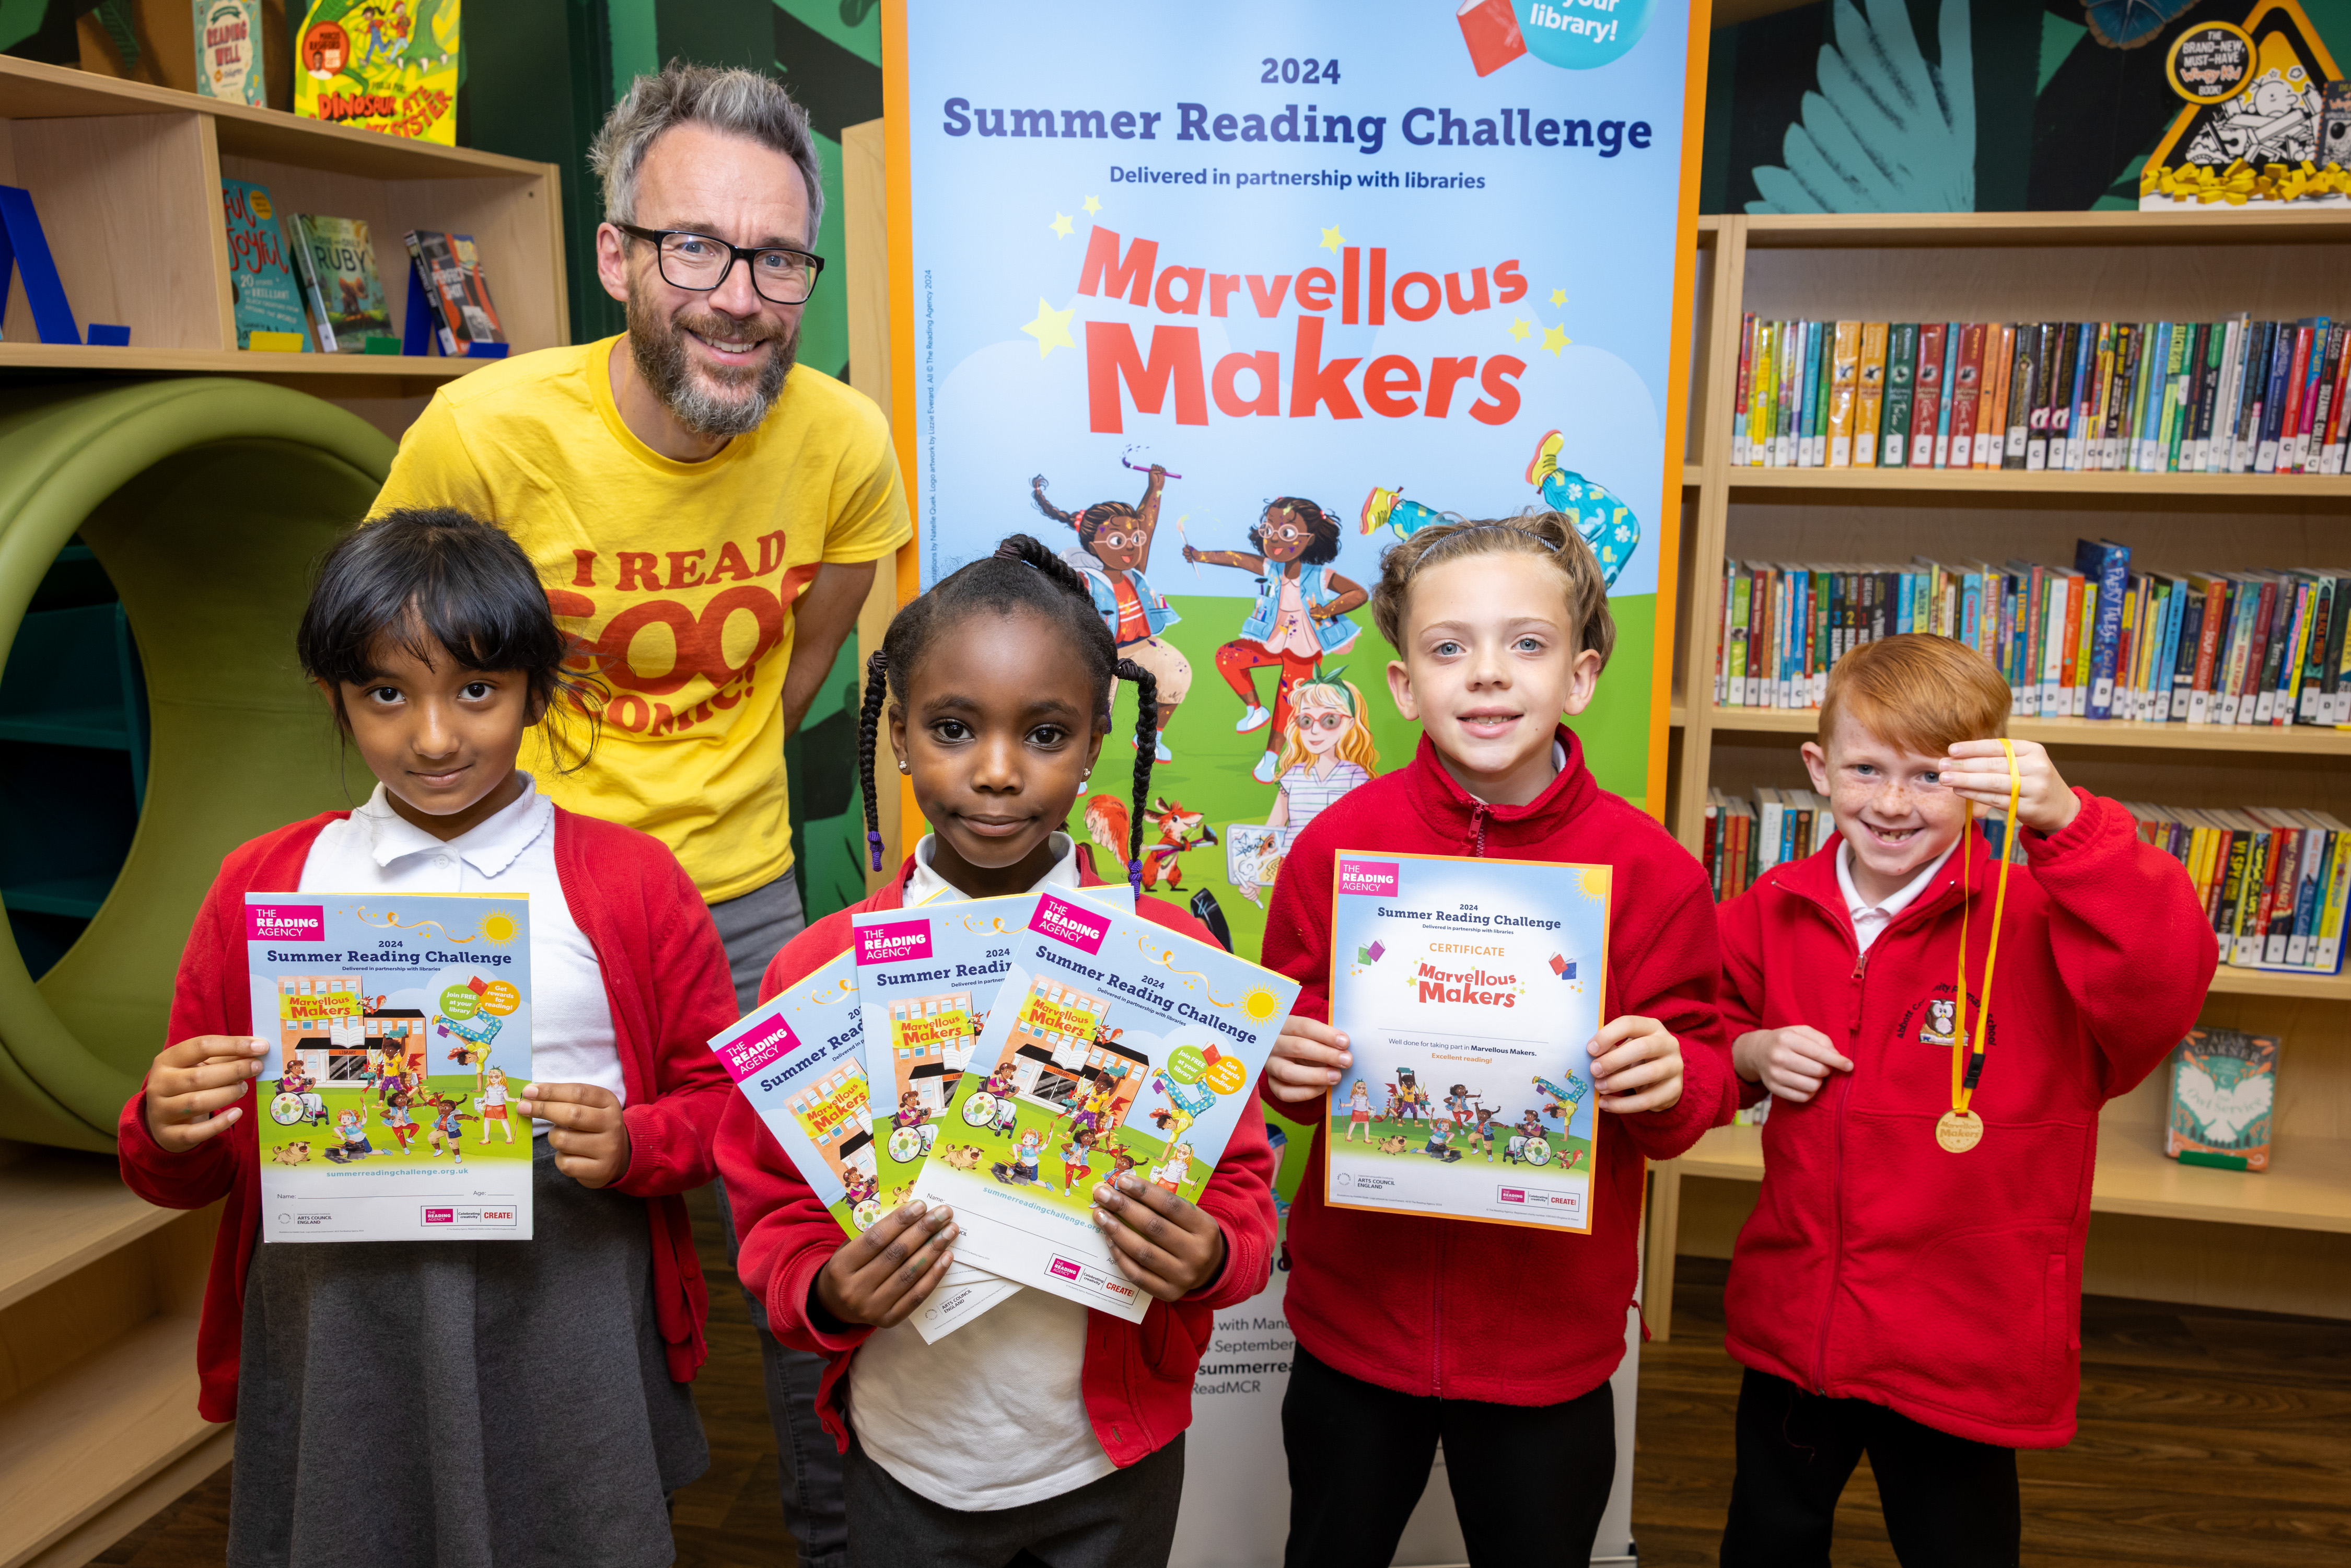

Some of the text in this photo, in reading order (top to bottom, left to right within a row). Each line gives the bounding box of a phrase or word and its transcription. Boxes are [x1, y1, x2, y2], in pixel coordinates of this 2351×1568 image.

[1530, 3, 1618, 43] library!
[207, 20, 247, 48] READING
[2208, 31, 2222, 40] THE
[215, 43, 241, 66] WELL
[2182, 40, 2245, 54] BRAND-NEW,
[2184, 52, 2240, 67] MUST-HAVE
[1260, 58, 1341, 85] 2024
[2198, 85, 2222, 96] BOOK!
[402, 85, 432, 115] ATE
[942, 97, 1652, 158] Summer Reading Challenge
[1109, 166, 1485, 191] Delivered in partnership with libraries
[315, 246, 366, 272] RUBY
[240, 274, 253, 287] 20
[1078, 224, 1529, 326] Marvellous
[925, 291, 934, 319] Agency
[926, 320, 934, 349] Reading
[1085, 315, 1527, 434] Makers
[928, 436, 936, 445] by
[930, 542, 938, 551] by
[572, 529, 786, 591] I READ
[1833, 611, 1842, 625] 3
[1846, 611, 1855, 625] 2
[1343, 864, 1359, 873] THE
[1342, 873, 1394, 884] READING
[1342, 882, 1381, 892] AGENCY
[256, 909, 276, 917] THE
[1049, 901, 1068, 915] THE
[256, 918, 318, 927] READING
[1042, 910, 1100, 939] READING
[1377, 907, 1561, 930] Summer Reading Challenge
[258, 927, 303, 936] AGENCY
[864, 929, 884, 939] THE
[1039, 920, 1083, 943] AGENCY
[865, 934, 926, 950] READING
[1429, 943, 1505, 957] CERTIFICATE
[267, 950, 511, 966] Summer Reading Challenge
[866, 946, 911, 960] AGENCY
[986, 948, 1010, 958] 2024
[877, 969, 951, 986] Summer
[1418, 962, 1517, 986] Marvellous
[1141, 975, 1165, 990] 2024
[289, 995, 350, 1007] Marvellous
[1035, 945, 1257, 1043] Summer Reading Challenge
[1418, 980, 1516, 1008] Makers
[292, 1004, 351, 1018] Makers
[485, 1002, 513, 1011] reading!
[1033, 999, 1089, 1024] Marvellous
[901, 1015, 960, 1031] Marvellous
[1029, 1011, 1085, 1037] Makers
[903, 1027, 962, 1046] Makers
[726, 1041, 747, 1057] THE
[731, 1028, 787, 1066] READING
[1430, 1041, 1448, 1050] taking
[1471, 1045, 1508, 1054] Marvellous
[1510, 1048, 1537, 1056] Makers.
[740, 1044, 779, 1075] AGENCY
[1431, 1053, 1492, 1064] Excellent reading!
[760, 1046, 827, 1091] Summer
[807, 1083, 858, 1121] Marvellous
[812, 1092, 866, 1133] Makers
[1940, 1129, 1980, 1139] Makers
[327, 1168, 469, 1178] summerreadingchallenge.org.uk
[927, 1193, 945, 1204] Name:
[1218, 1318, 1249, 1330] with
[1215, 1339, 1294, 1354] September
